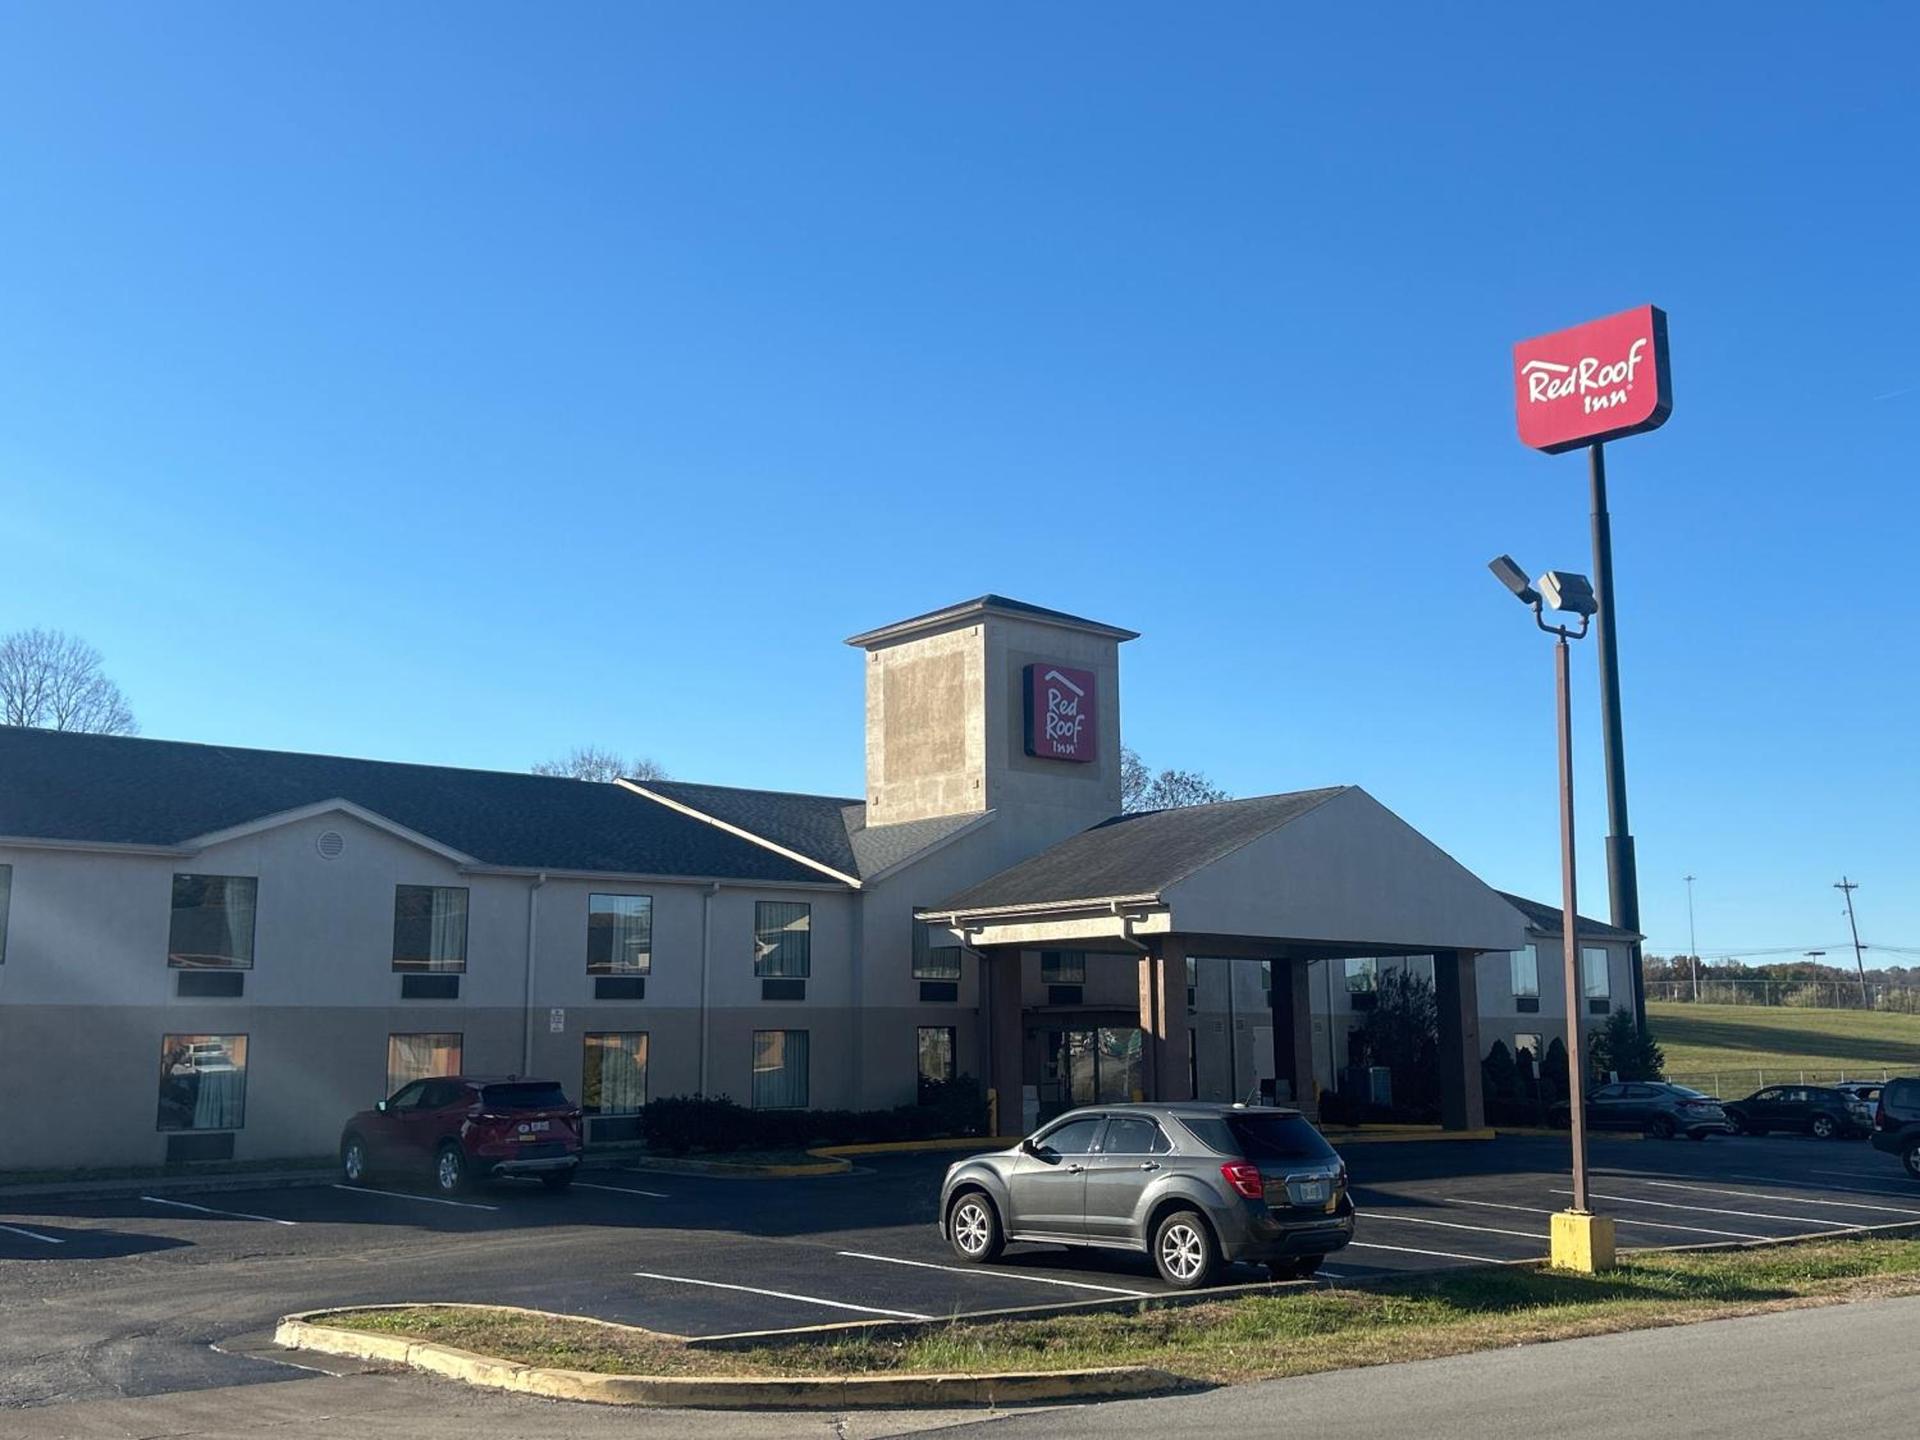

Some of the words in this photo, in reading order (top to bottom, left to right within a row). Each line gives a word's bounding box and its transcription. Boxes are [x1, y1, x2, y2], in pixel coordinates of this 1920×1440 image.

[1528, 367, 1578, 403] Red
[1579, 338, 1647, 395] Roof
[1584, 389, 1628, 414] Inn
[1048, 688, 1078, 716] Red
[1046, 712, 1085, 743] Roof
[1053, 740, 1075, 754] Inn
